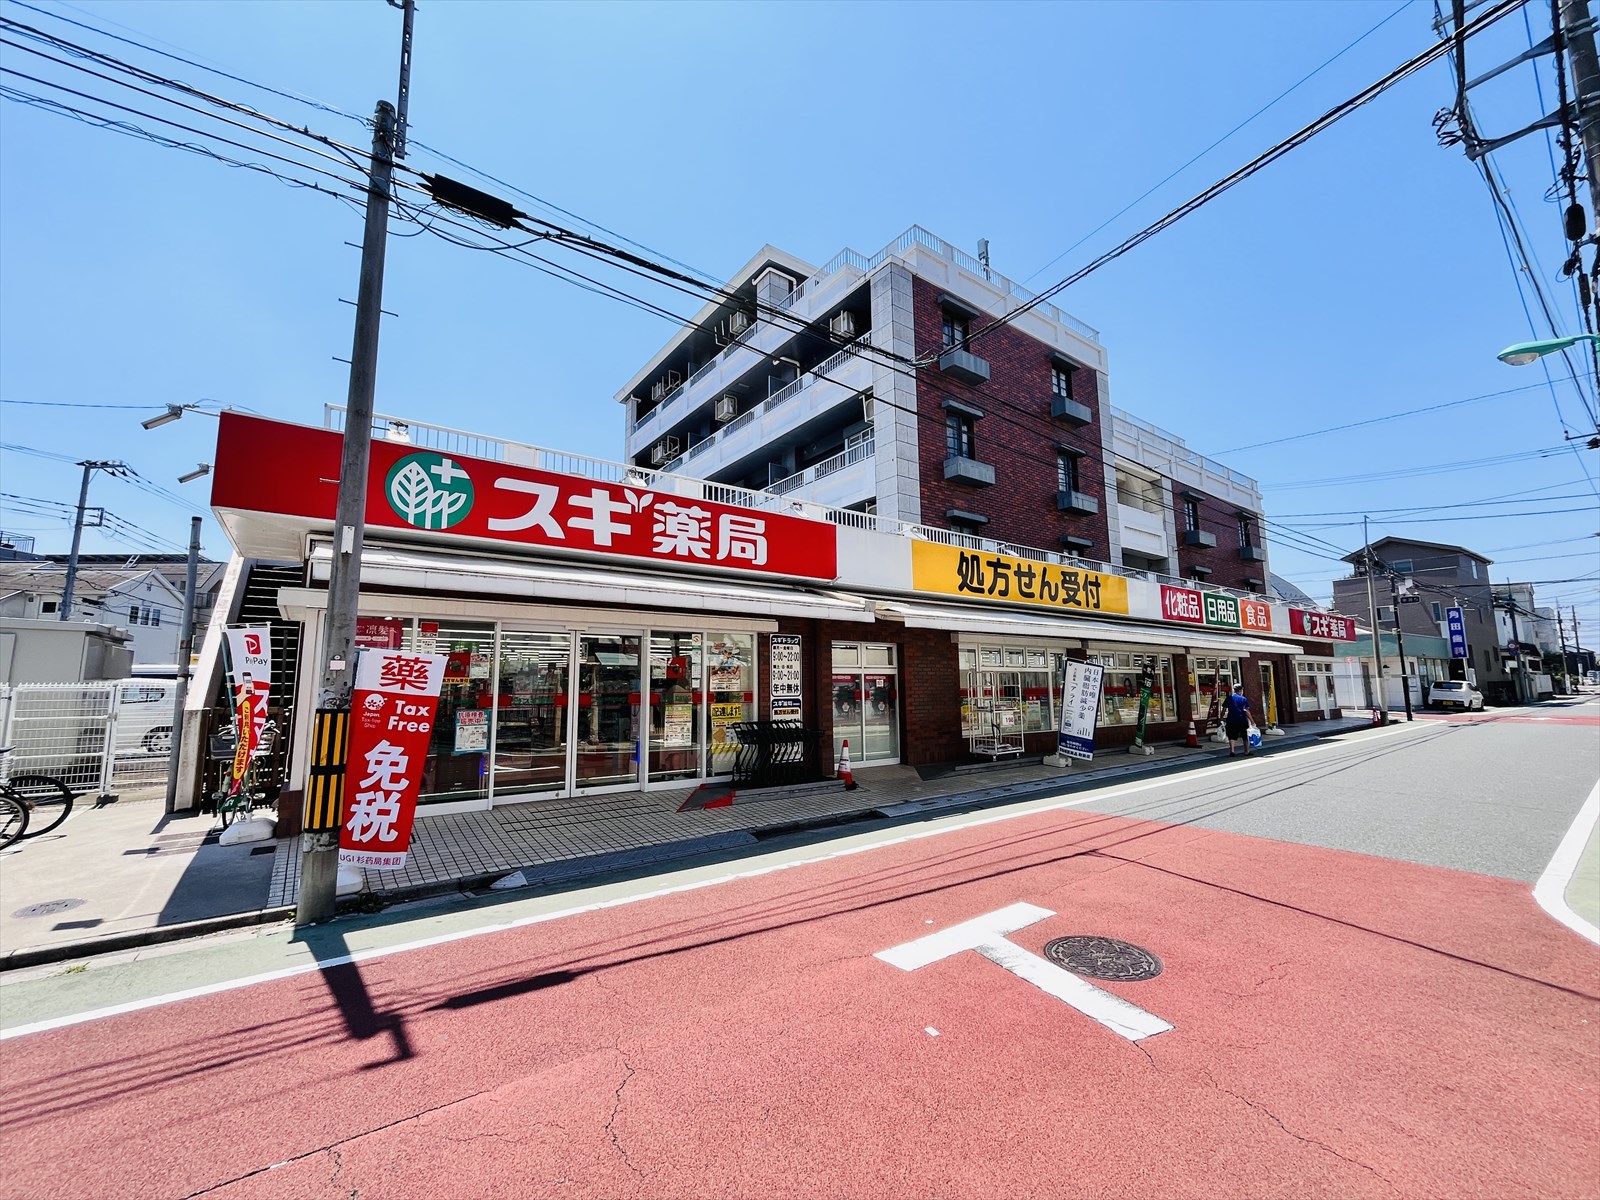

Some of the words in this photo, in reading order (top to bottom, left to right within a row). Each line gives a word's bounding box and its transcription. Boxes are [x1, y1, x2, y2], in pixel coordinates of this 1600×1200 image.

[488, 476, 768, 566] スギ薬局
[957, 550, 1101, 610] 処方せん受付
[1165, 589, 1200, 619] 化粧品
[1207, 597, 1237, 624] 日用品
[1245, 604, 1267, 627] 食品
[1311, 615, 1347, 639] スギ薬局
[1448, 610, 1465, 656] 角田歯科
[379, 655, 432, 690] 藥
[773, 683, 800, 694] 年中無休
[395, 699, 431, 717] Tax
[387, 716, 430, 733] Free
[346, 739, 410, 843] 免税
